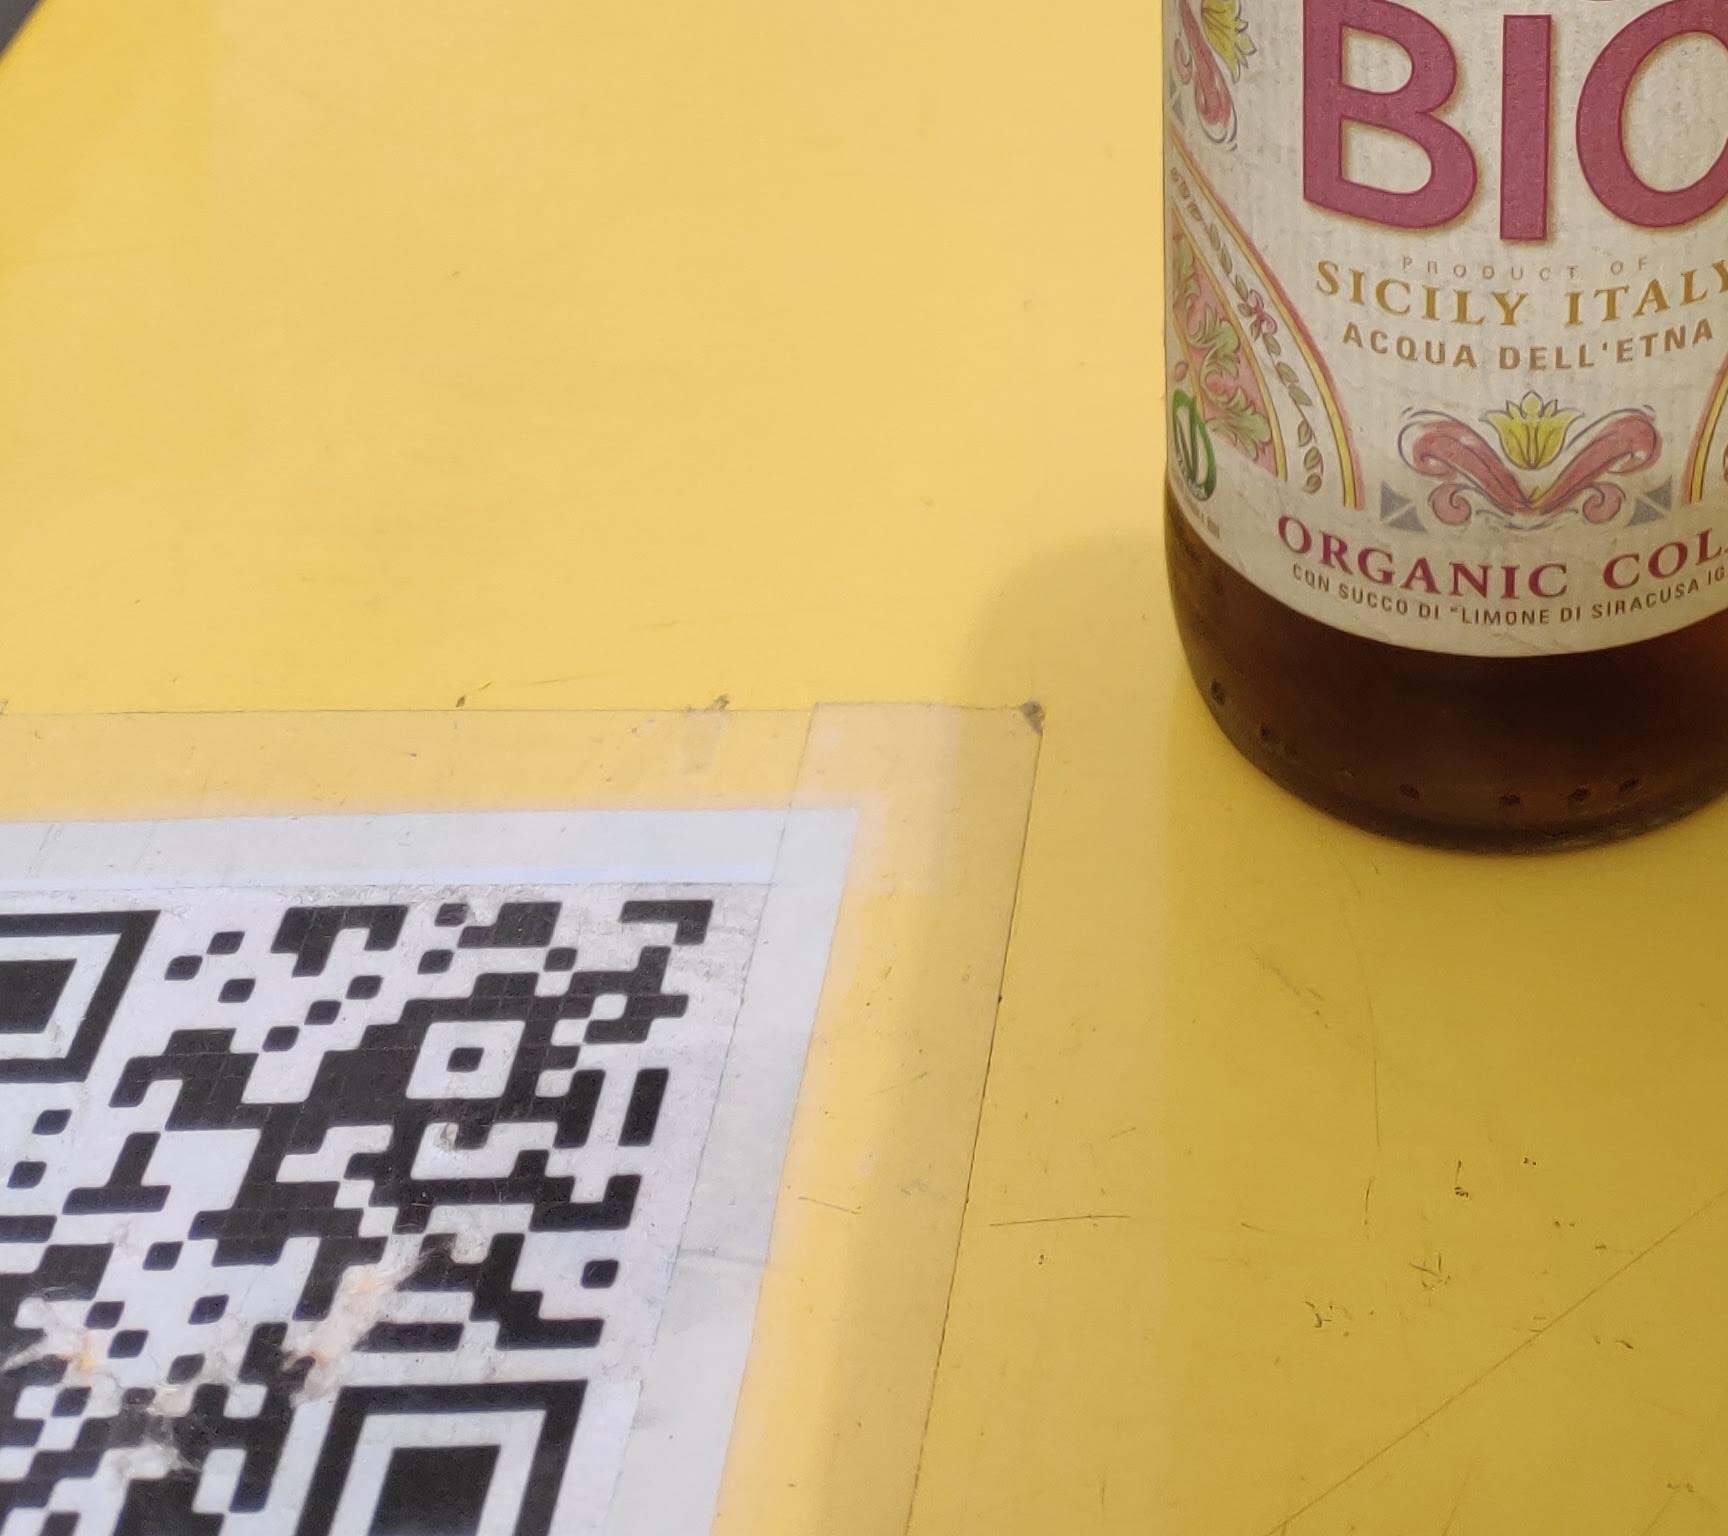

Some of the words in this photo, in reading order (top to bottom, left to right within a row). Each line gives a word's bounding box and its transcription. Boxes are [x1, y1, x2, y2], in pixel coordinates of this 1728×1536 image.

[1316, 259, 1529, 327] SICILY
[1402, 256, 1578, 282] PRODUCT
[1610, 256, 1648, 276] OF
[1342, 321, 1478, 369] ACQUA
[1500, 317, 1714, 371] DELL'ETNA
[1277, 514, 1568, 601] ORGANIC
[1292, 563, 1331, 594] CON
[1338, 581, 1408, 617] SUCCO
[1418, 603, 1440, 621] DI
[1560, 604, 1582, 624] DI
[1592, 577, 1700, 620] SIRACUSA
